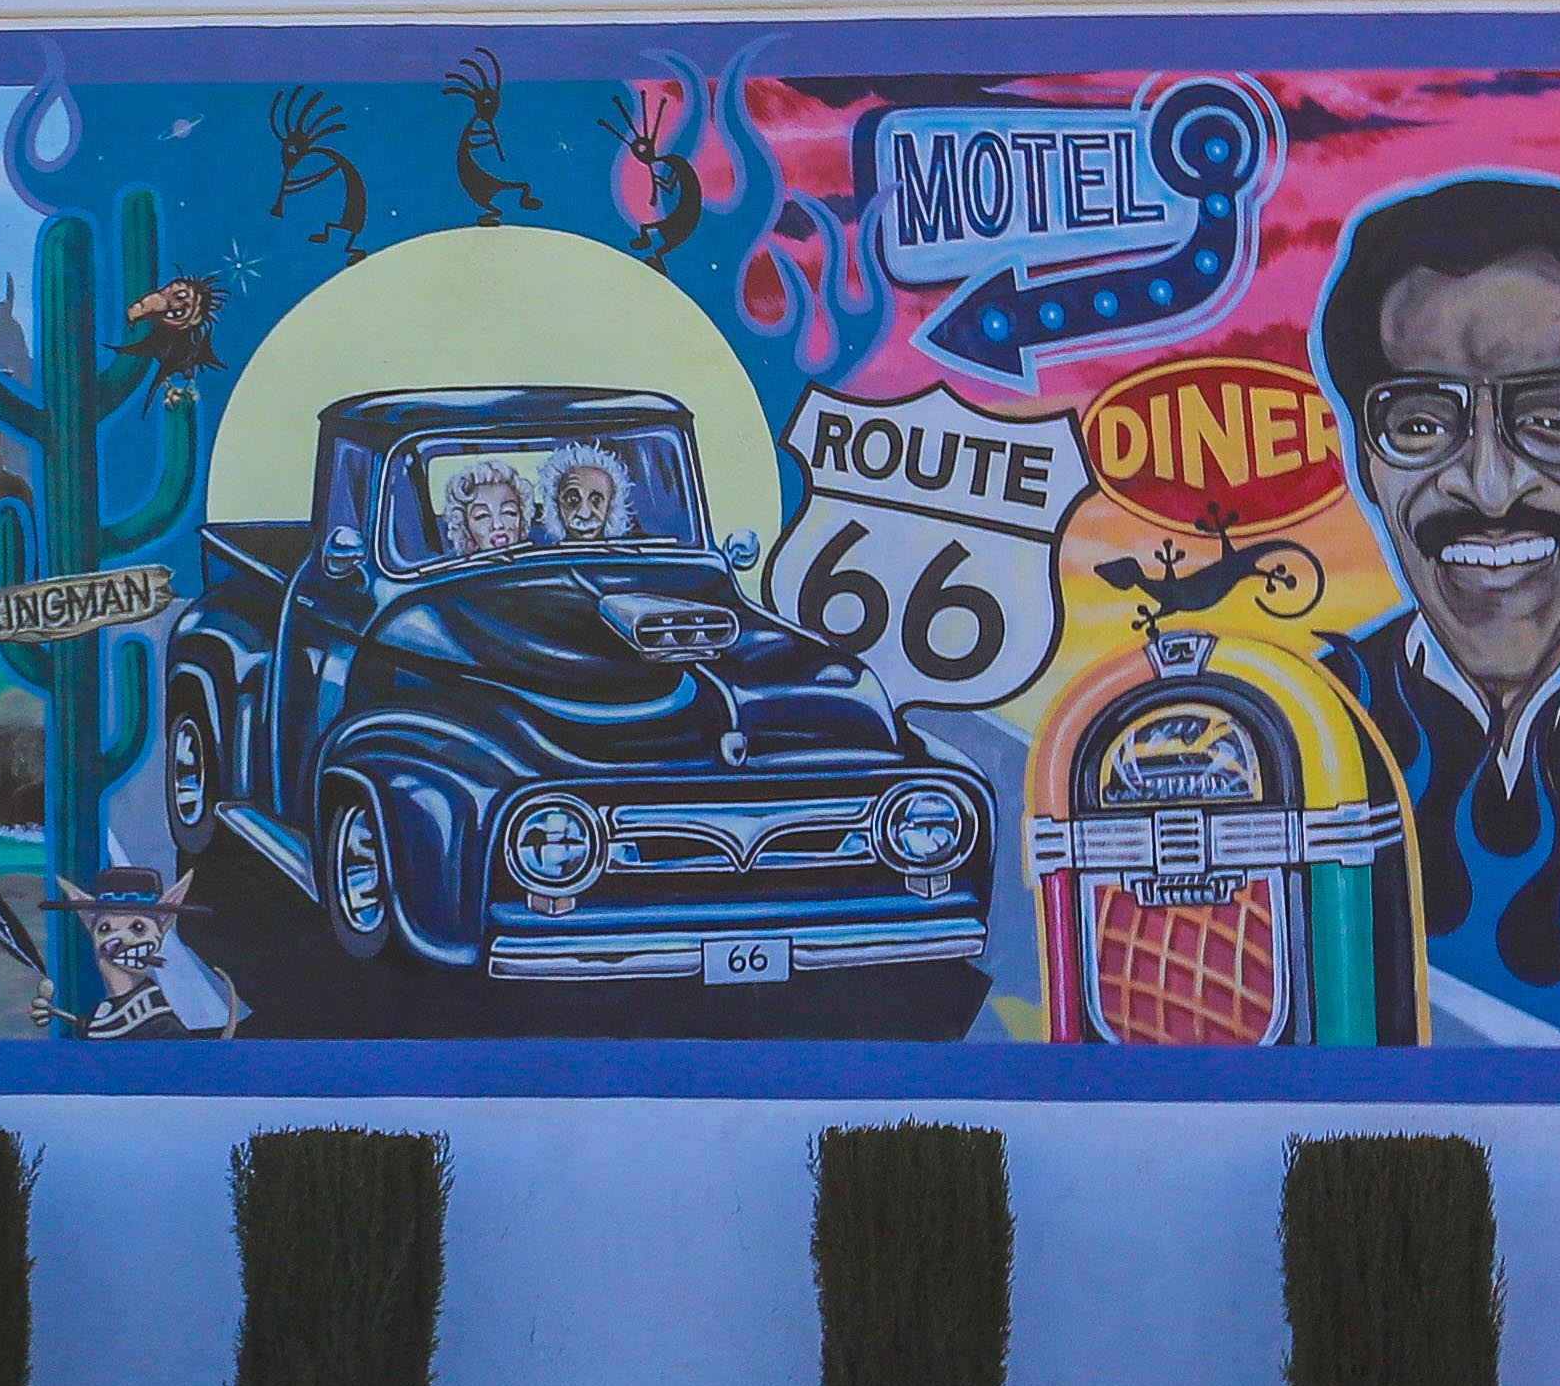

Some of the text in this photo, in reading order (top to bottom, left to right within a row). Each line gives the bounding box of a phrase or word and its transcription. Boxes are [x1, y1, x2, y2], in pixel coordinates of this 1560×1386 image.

[892, 131, 1165, 247] MOTEL
[810, 410, 1054, 507] ROUTE
[1097, 383, 1343, 490] DINER
[797, 519, 1005, 681] 66
[728, 944, 769, 974] 66
